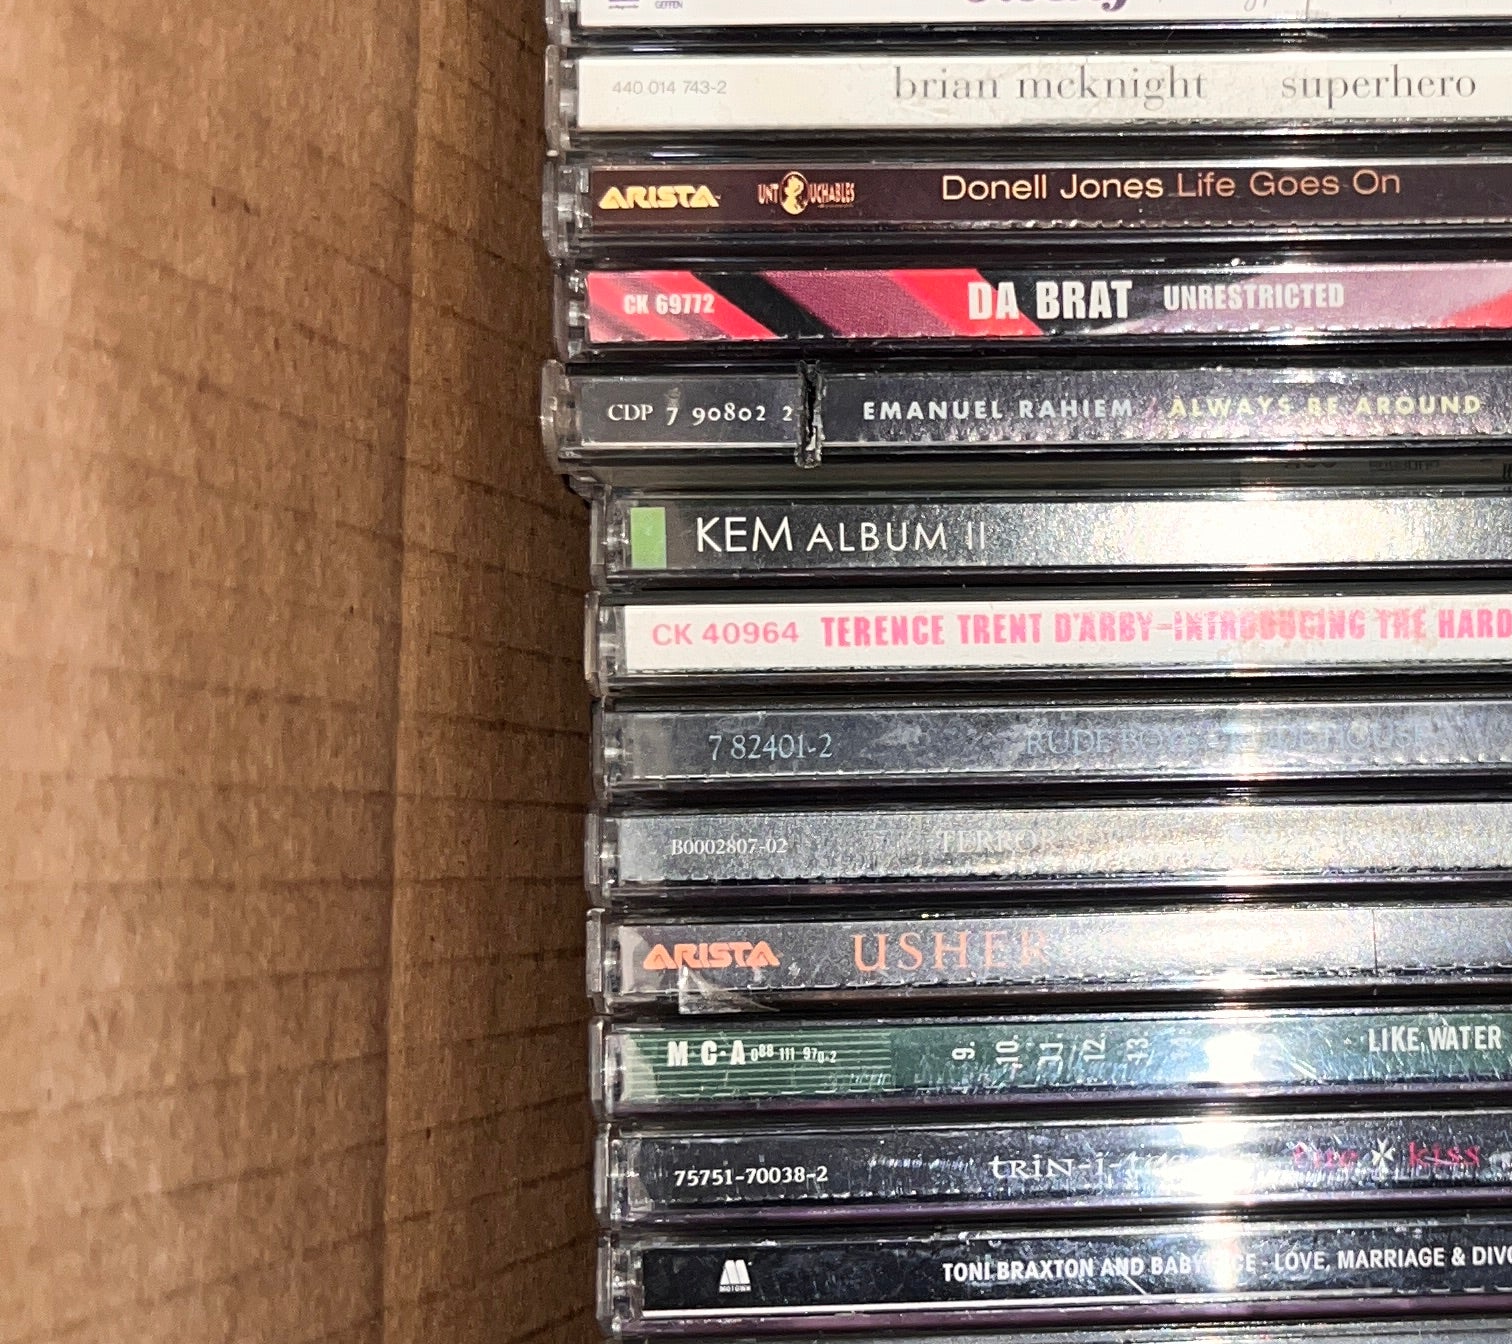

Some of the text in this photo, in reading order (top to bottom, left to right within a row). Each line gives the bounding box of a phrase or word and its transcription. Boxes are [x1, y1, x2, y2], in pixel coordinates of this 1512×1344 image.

[683, 80, 727, 94] 743-2
[894, 64, 1476, 108] brian mcknight superhero
[599, 187, 720, 209] ARISTA
[942, 174, 1165, 201] Donell Jones
[656, 294, 715, 314] 69772
[1036, 281, 1345, 319] BRAT UNRESTRICTED
[693, 404, 766, 423] 90802
[864, 401, 1133, 420] EMANUEL RAHIEM
[697, 517, 947, 554] KEM ALBUM
[821, 615, 945, 647] TERENCE
[958, 614, 1041, 644] TRENT
[730, 734, 833, 759] 82401-2
[671, 837, 787, 856] B0002807-02
[853, 932, 1050, 972] USHER
[674, 1166, 828, 1187] 75751-70038-2
[997, 1259, 1096, 1280] BRAXTON
[1338, 1247, 1445, 1269] MARRIAGE
